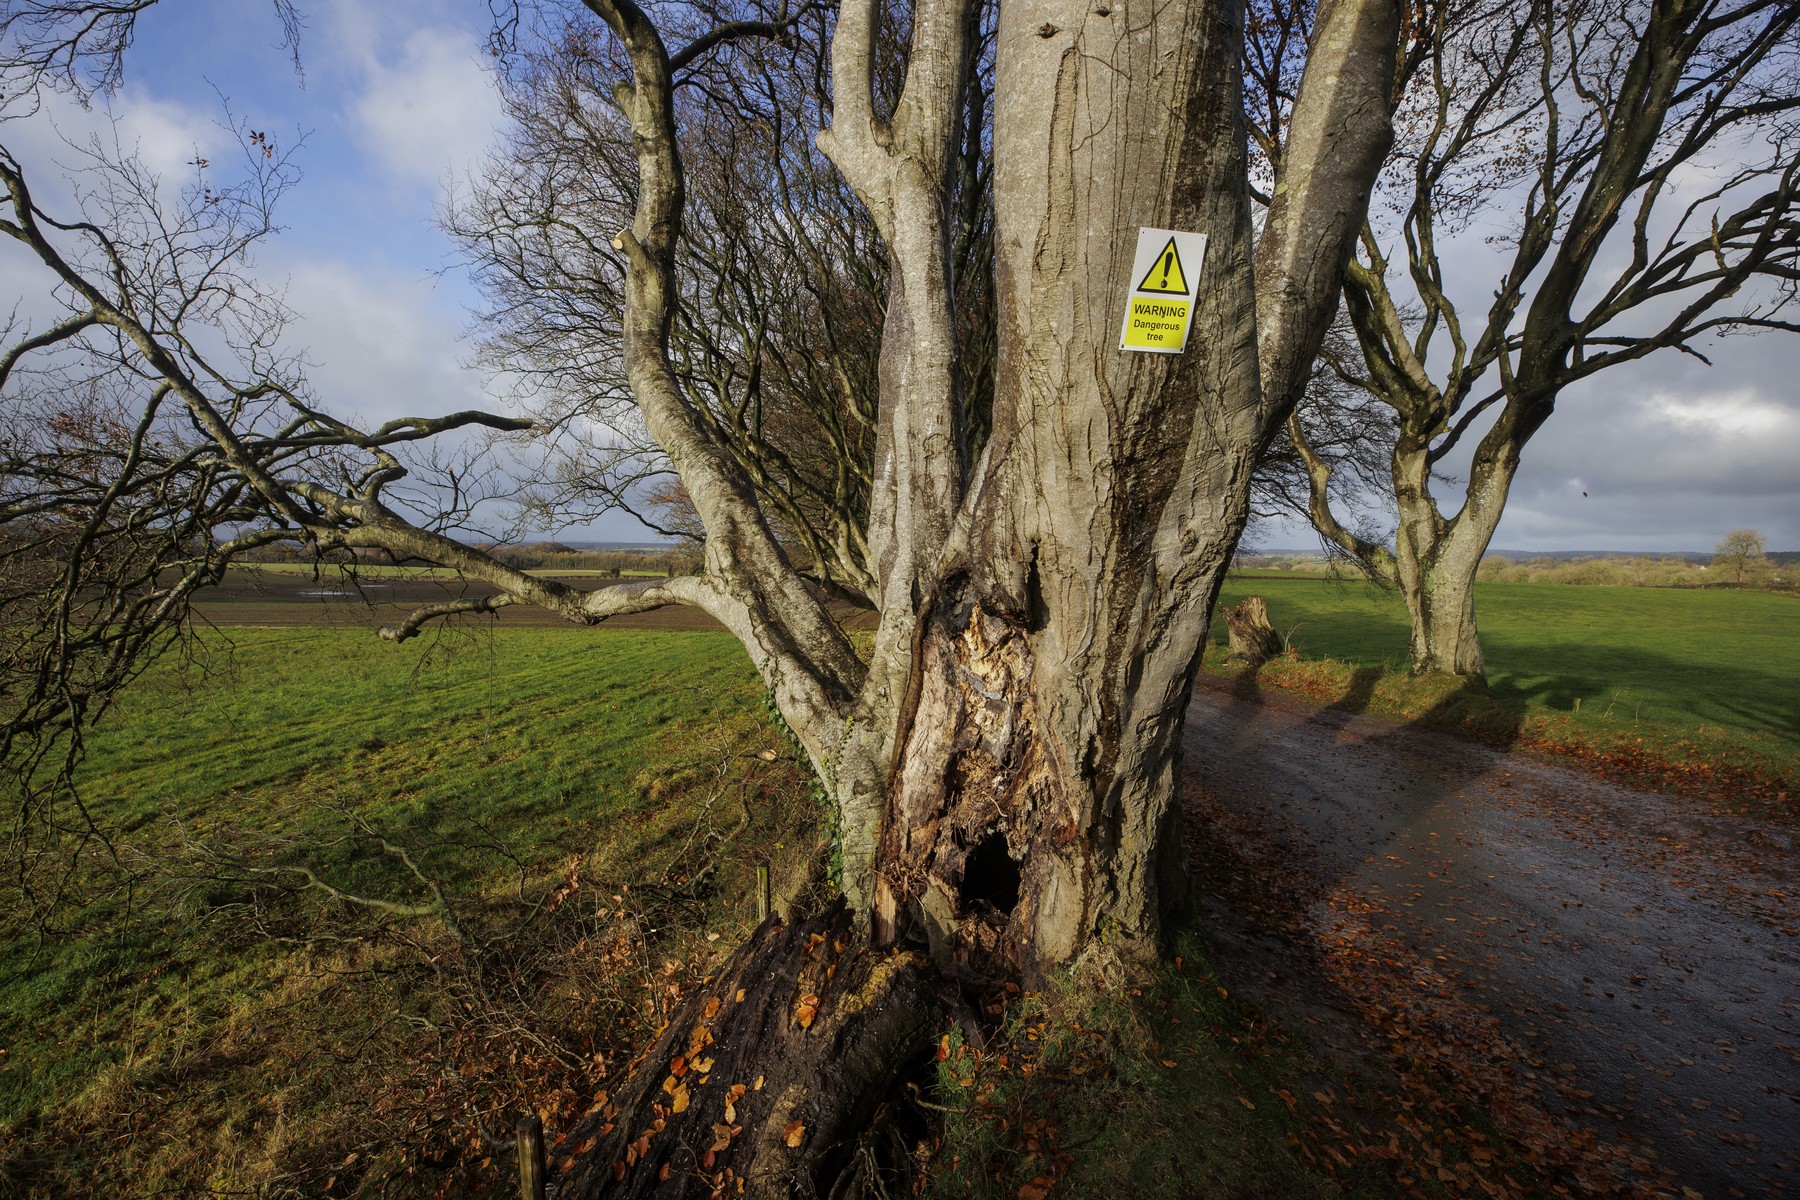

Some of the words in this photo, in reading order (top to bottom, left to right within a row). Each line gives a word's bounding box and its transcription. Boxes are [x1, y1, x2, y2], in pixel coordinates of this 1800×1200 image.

[1134, 304, 1186, 318] WARNING
[1133, 319, 1180, 331] Dangerous
[1147, 332, 1164, 341] tree
